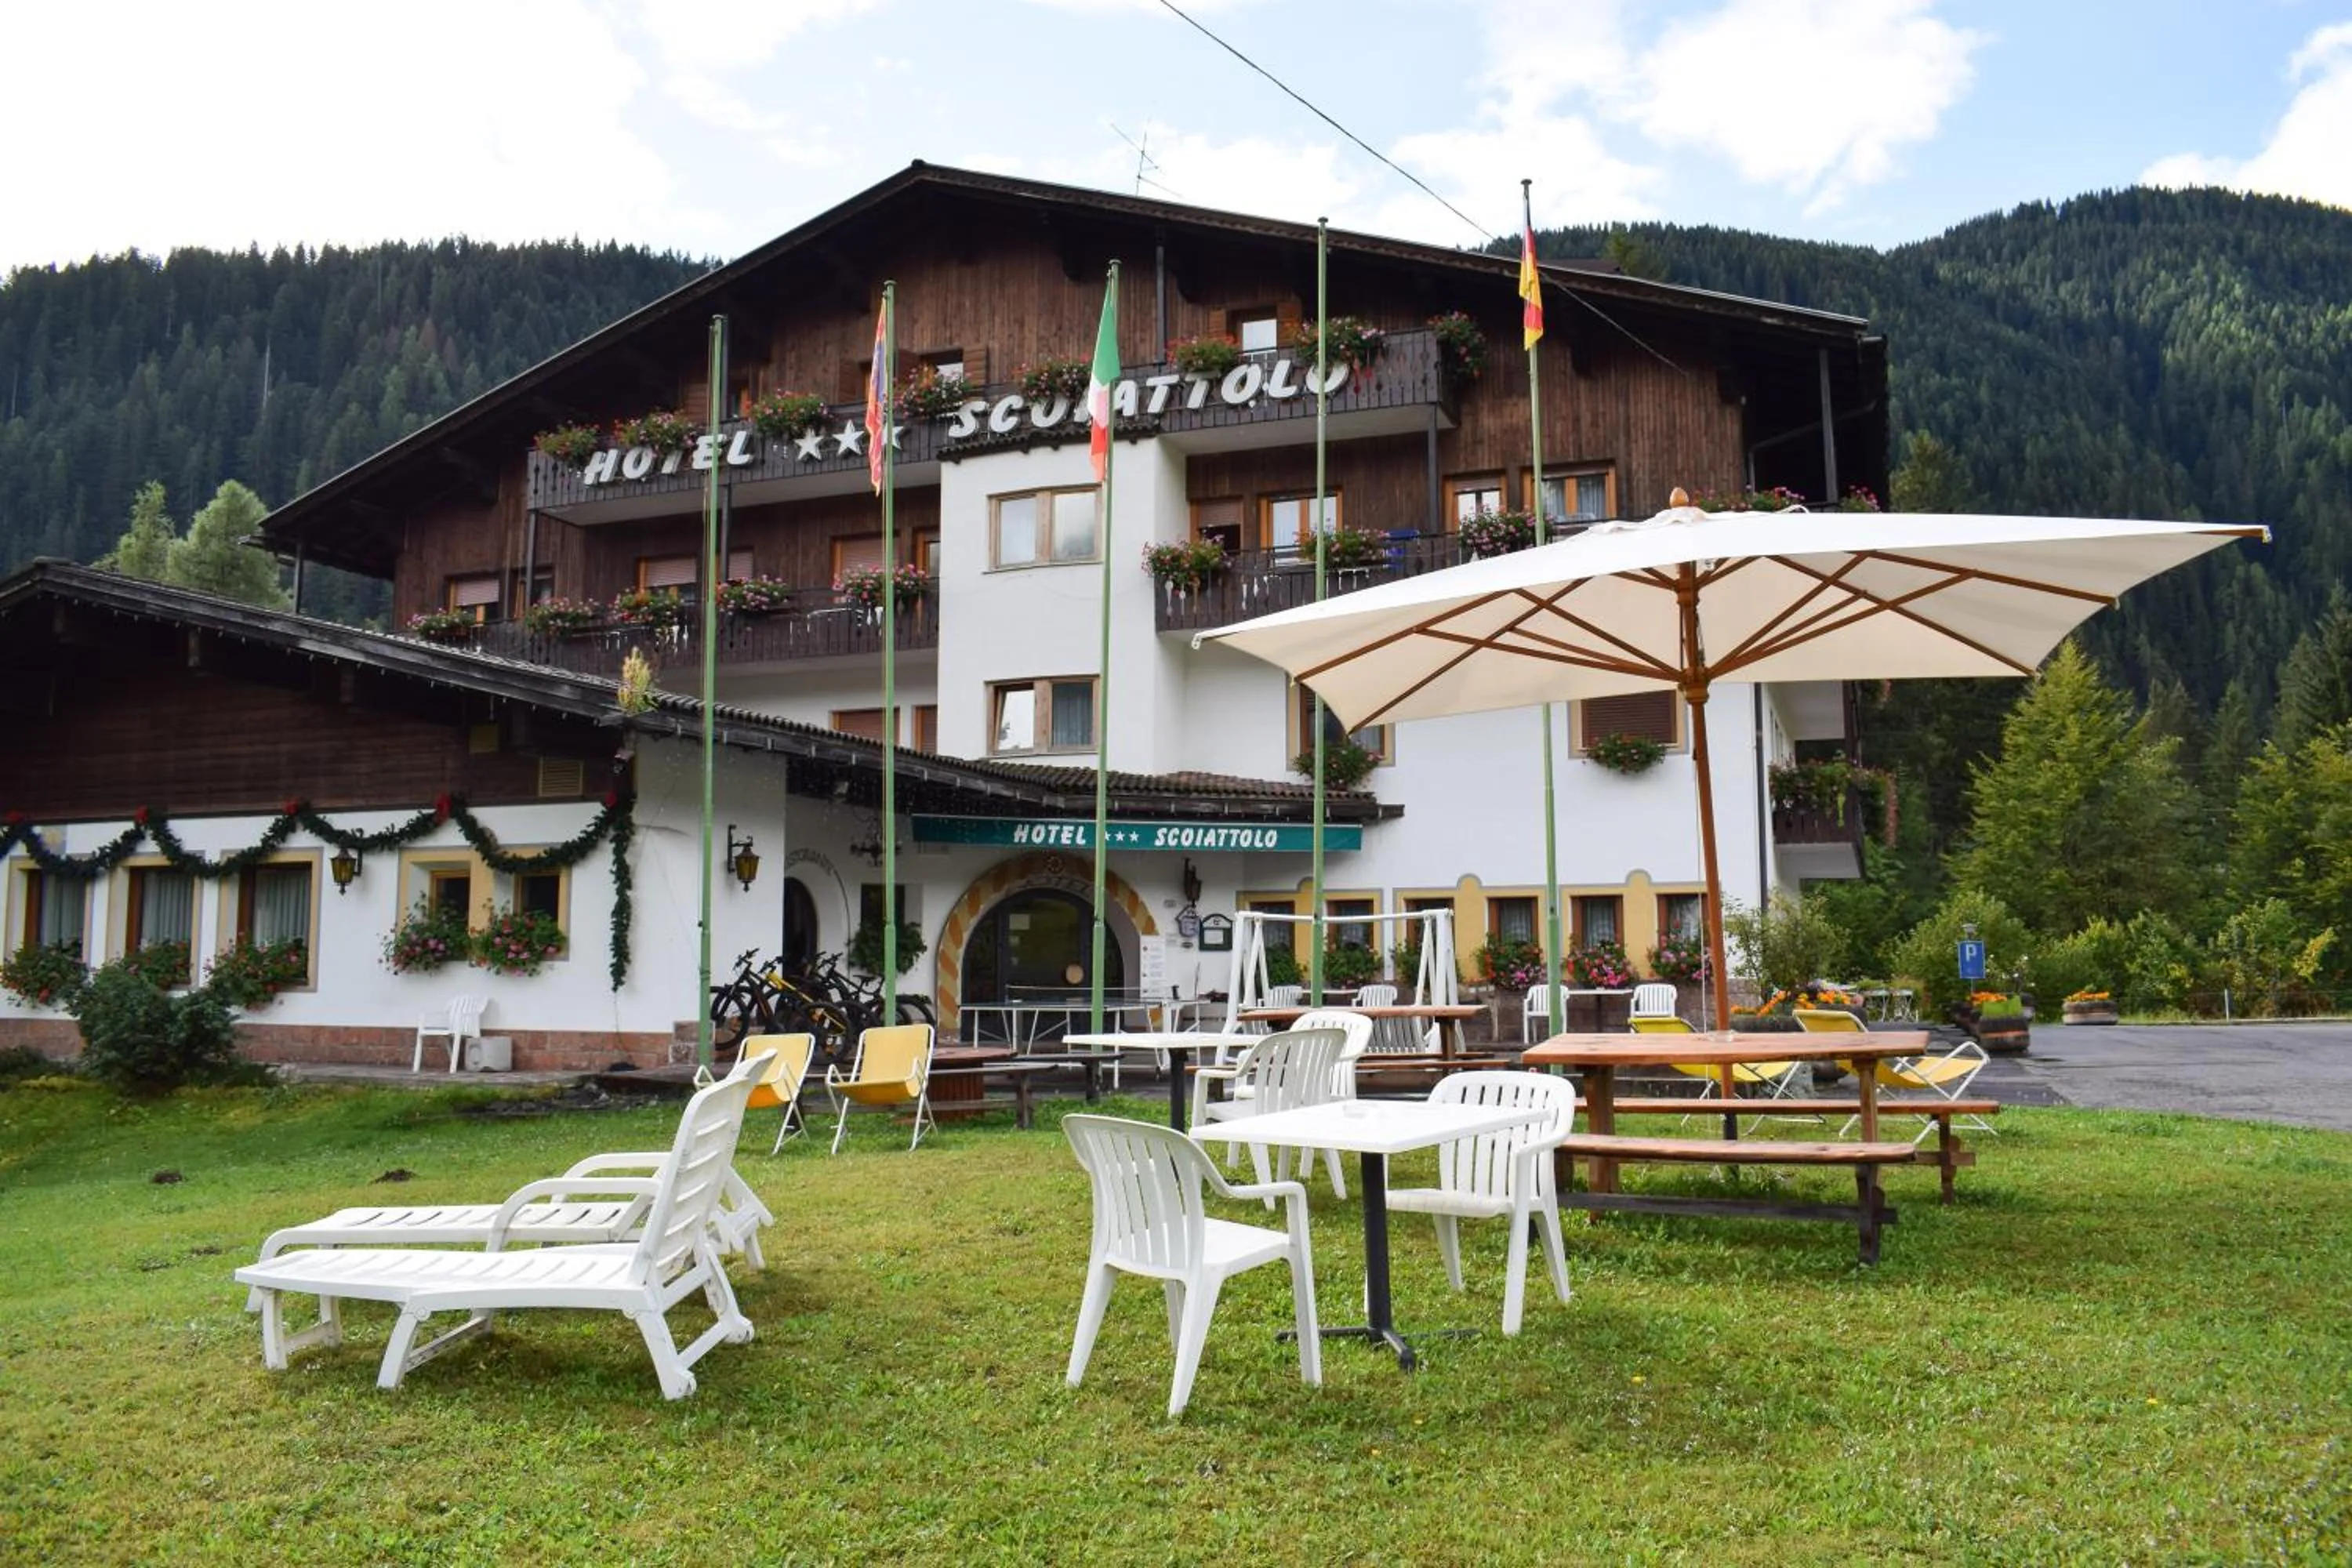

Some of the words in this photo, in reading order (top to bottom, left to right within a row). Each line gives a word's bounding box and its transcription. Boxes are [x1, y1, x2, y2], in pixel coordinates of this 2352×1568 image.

[1013, 824, 1087, 844] HOTEL
[1153, 827, 1278, 848] SCOIATTOLO
[1965, 944, 1977, 962] P
